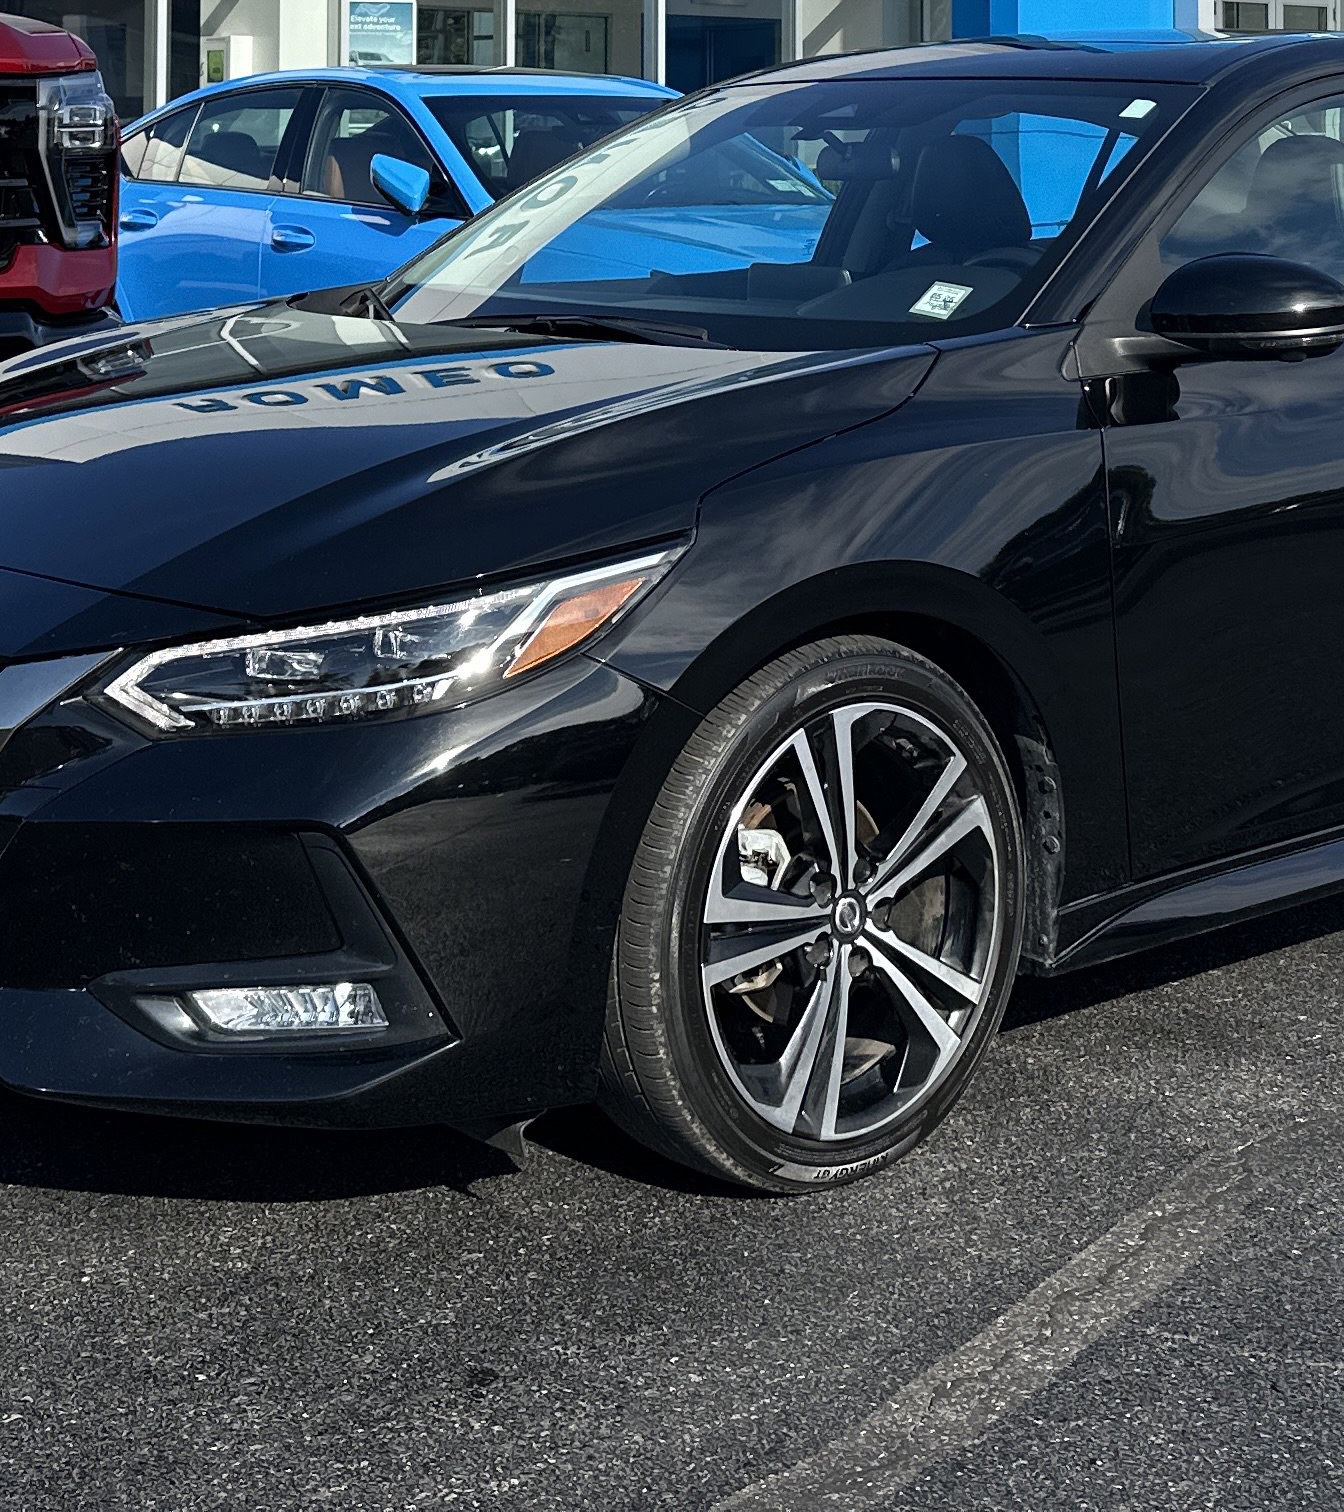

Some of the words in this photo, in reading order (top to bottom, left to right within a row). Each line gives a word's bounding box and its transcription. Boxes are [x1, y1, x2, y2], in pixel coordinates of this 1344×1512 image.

[350, 15, 378, 23] Elevate
[378, 16, 396, 24] your
[362, 23, 401, 31] adventure
